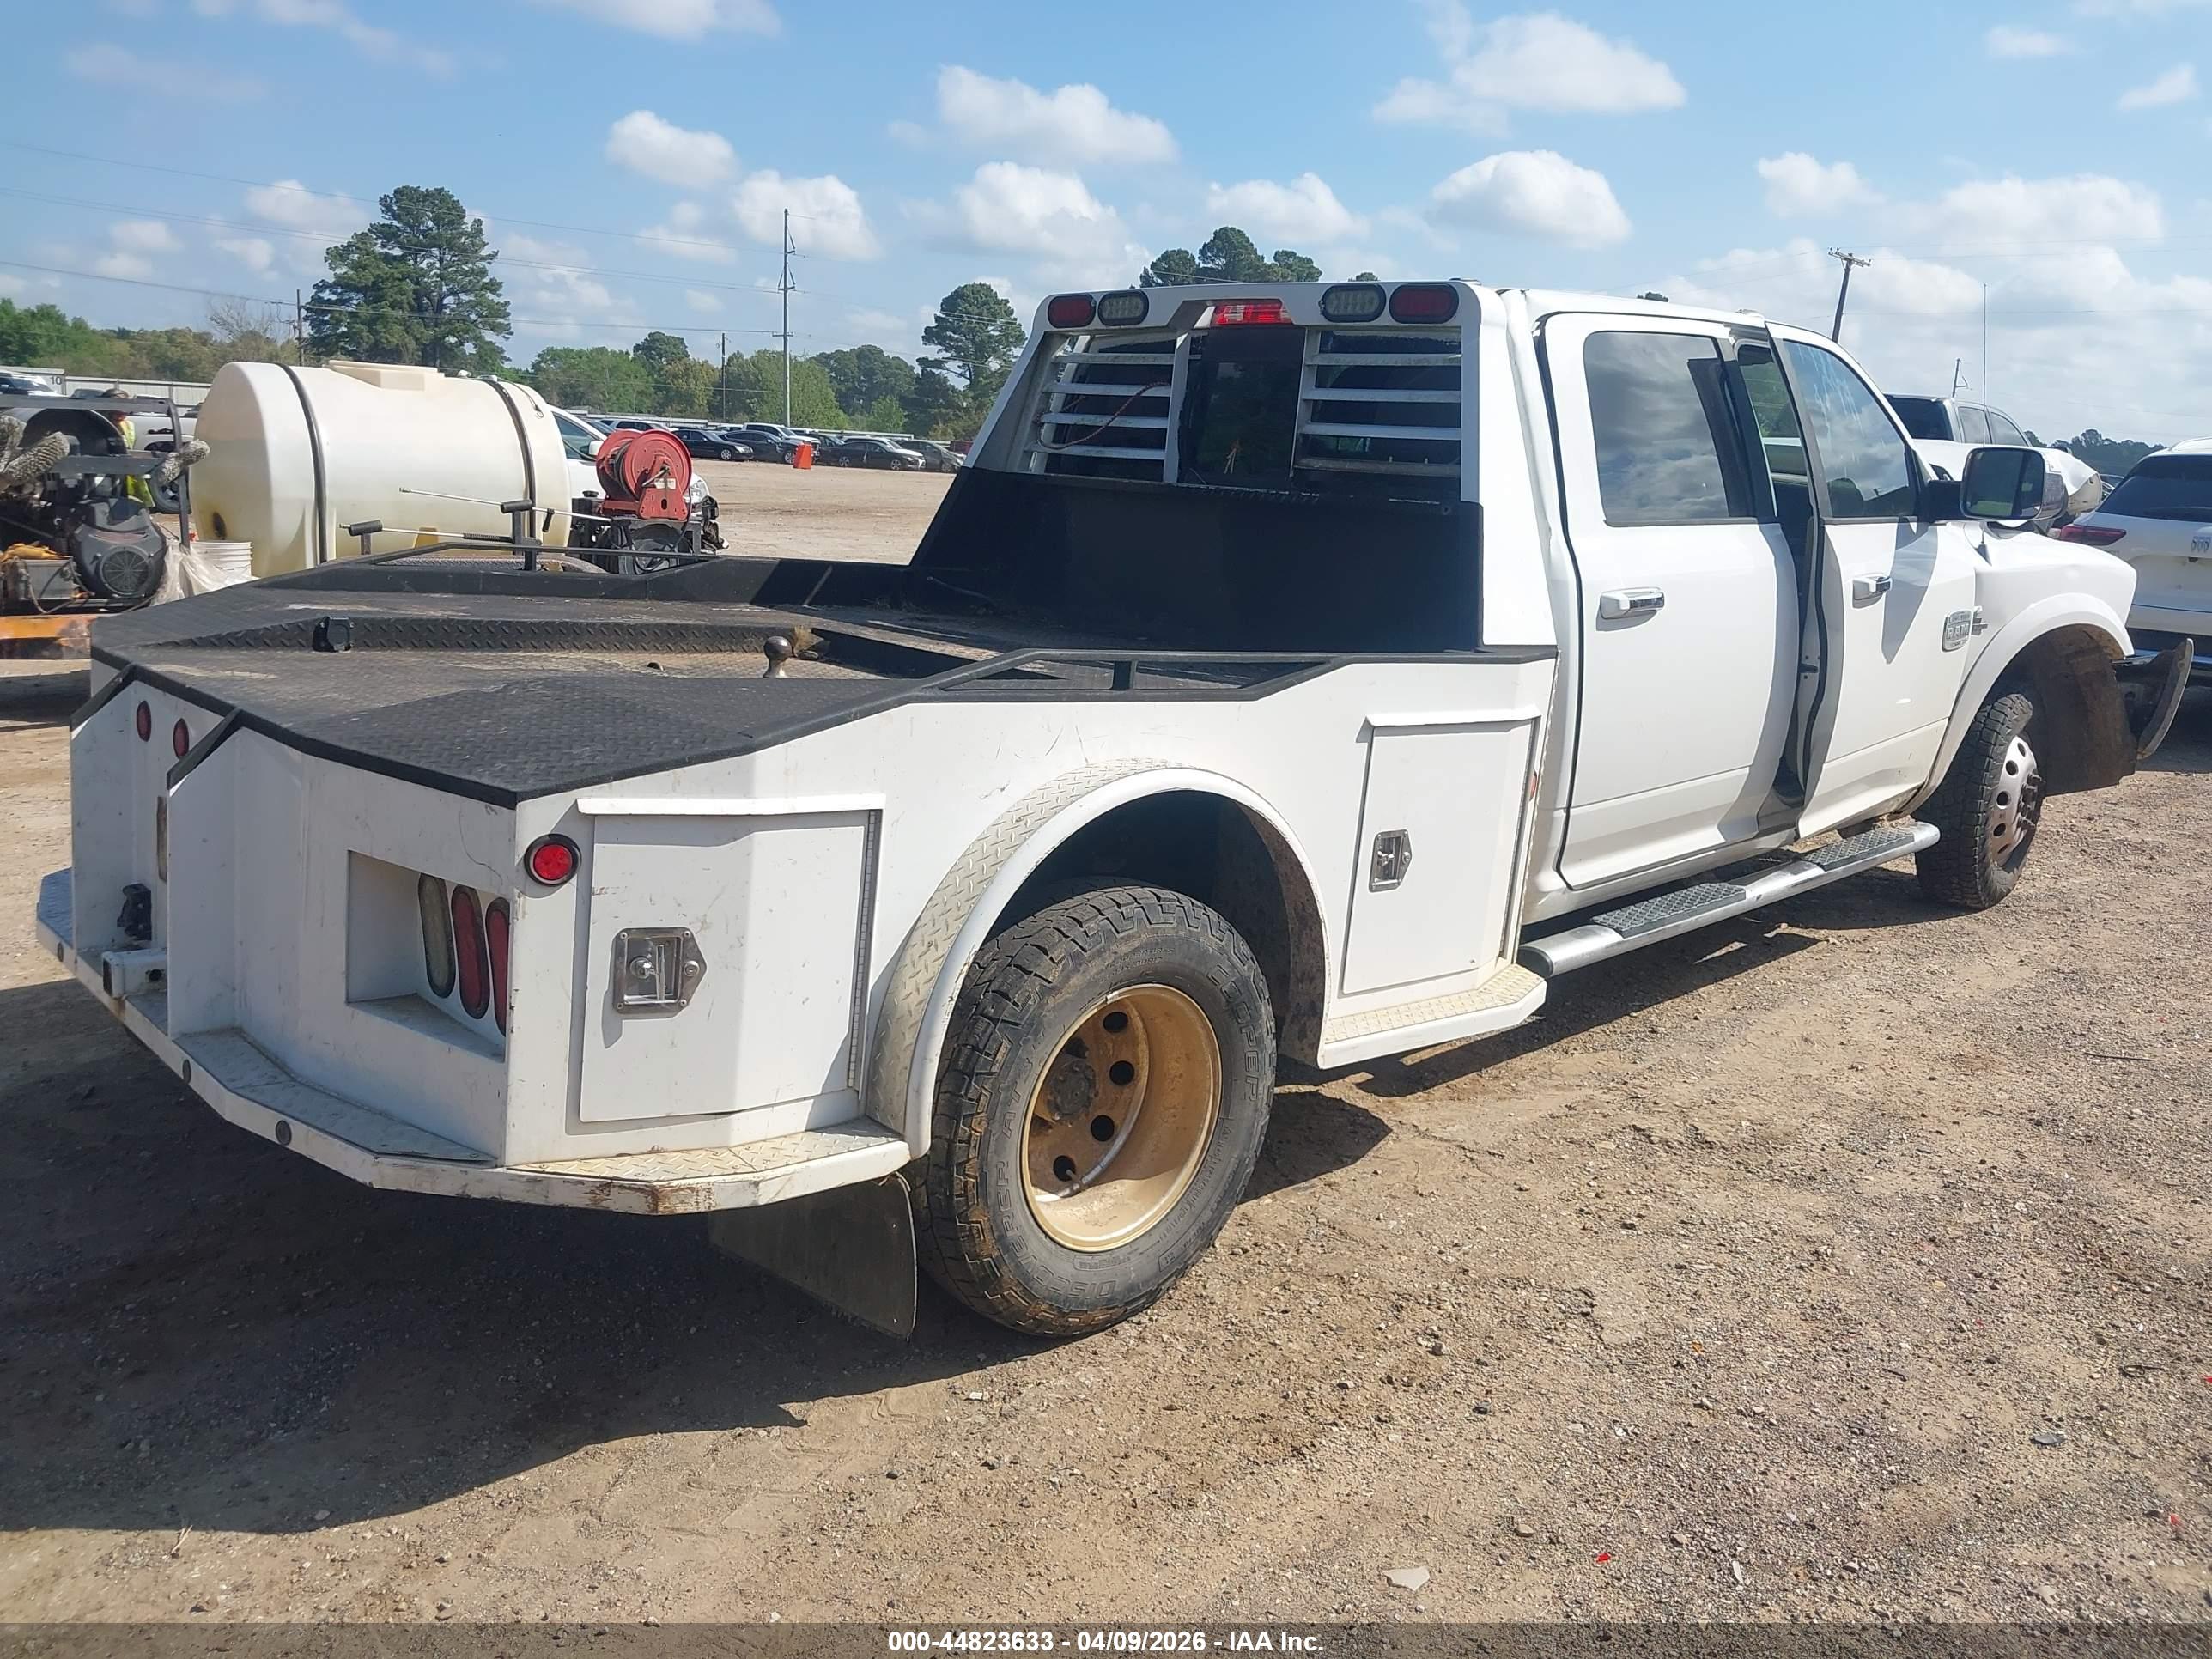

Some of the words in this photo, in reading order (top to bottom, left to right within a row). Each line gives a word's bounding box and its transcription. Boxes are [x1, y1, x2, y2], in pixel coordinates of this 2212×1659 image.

[49, 376, 63, 386] 10
[1946, 623, 1970, 640] RAM
[1206, 963, 1260, 1102] COOPER
[996, 1160, 1116, 1298] DISCOVERER
